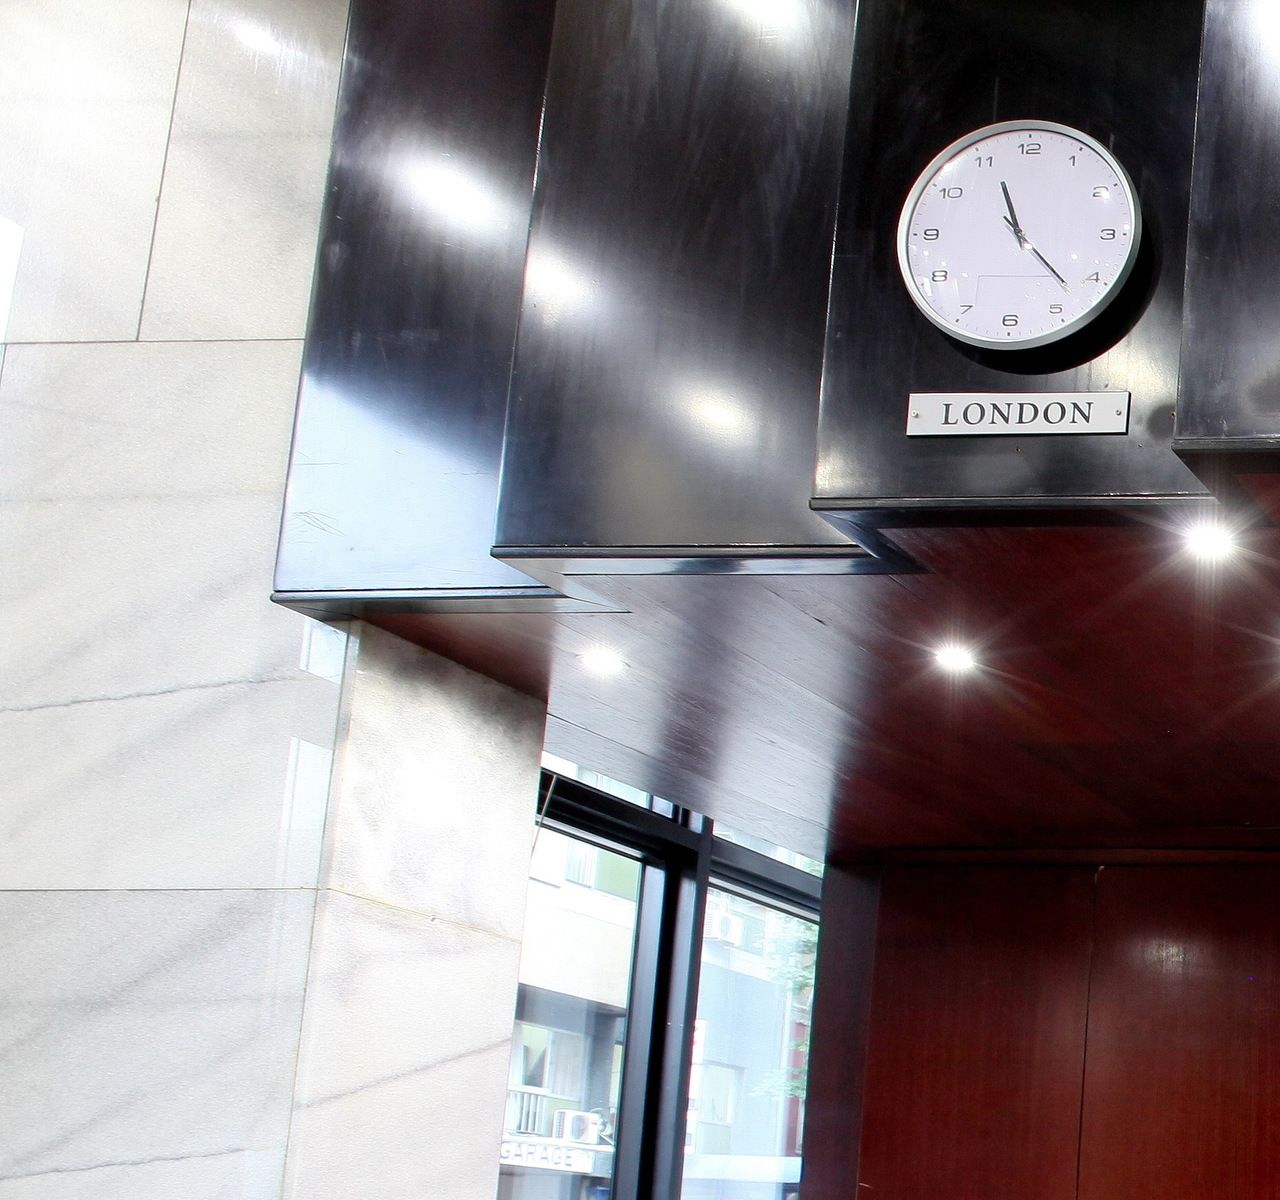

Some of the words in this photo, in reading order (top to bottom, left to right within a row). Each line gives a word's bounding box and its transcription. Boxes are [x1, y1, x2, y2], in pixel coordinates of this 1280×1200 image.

[1016, 142, 1043, 156] 12
[974, 156, 994, 168] 11
[1068, 155, 1077, 167] 1
[938, 186, 964, 199] 10
[922, 228, 941, 242] 9
[1099, 228, 1117, 241] 3
[931, 269, 948, 283] 8
[1084, 271, 1101, 284] 4
[958, 303, 974, 315] 7
[1048, 302, 1064, 315] 5
[1001, 313, 1020, 328] 6
[940, 400, 1095, 426] LONDON
[499, 1139, 574, 1167] GARAGE
